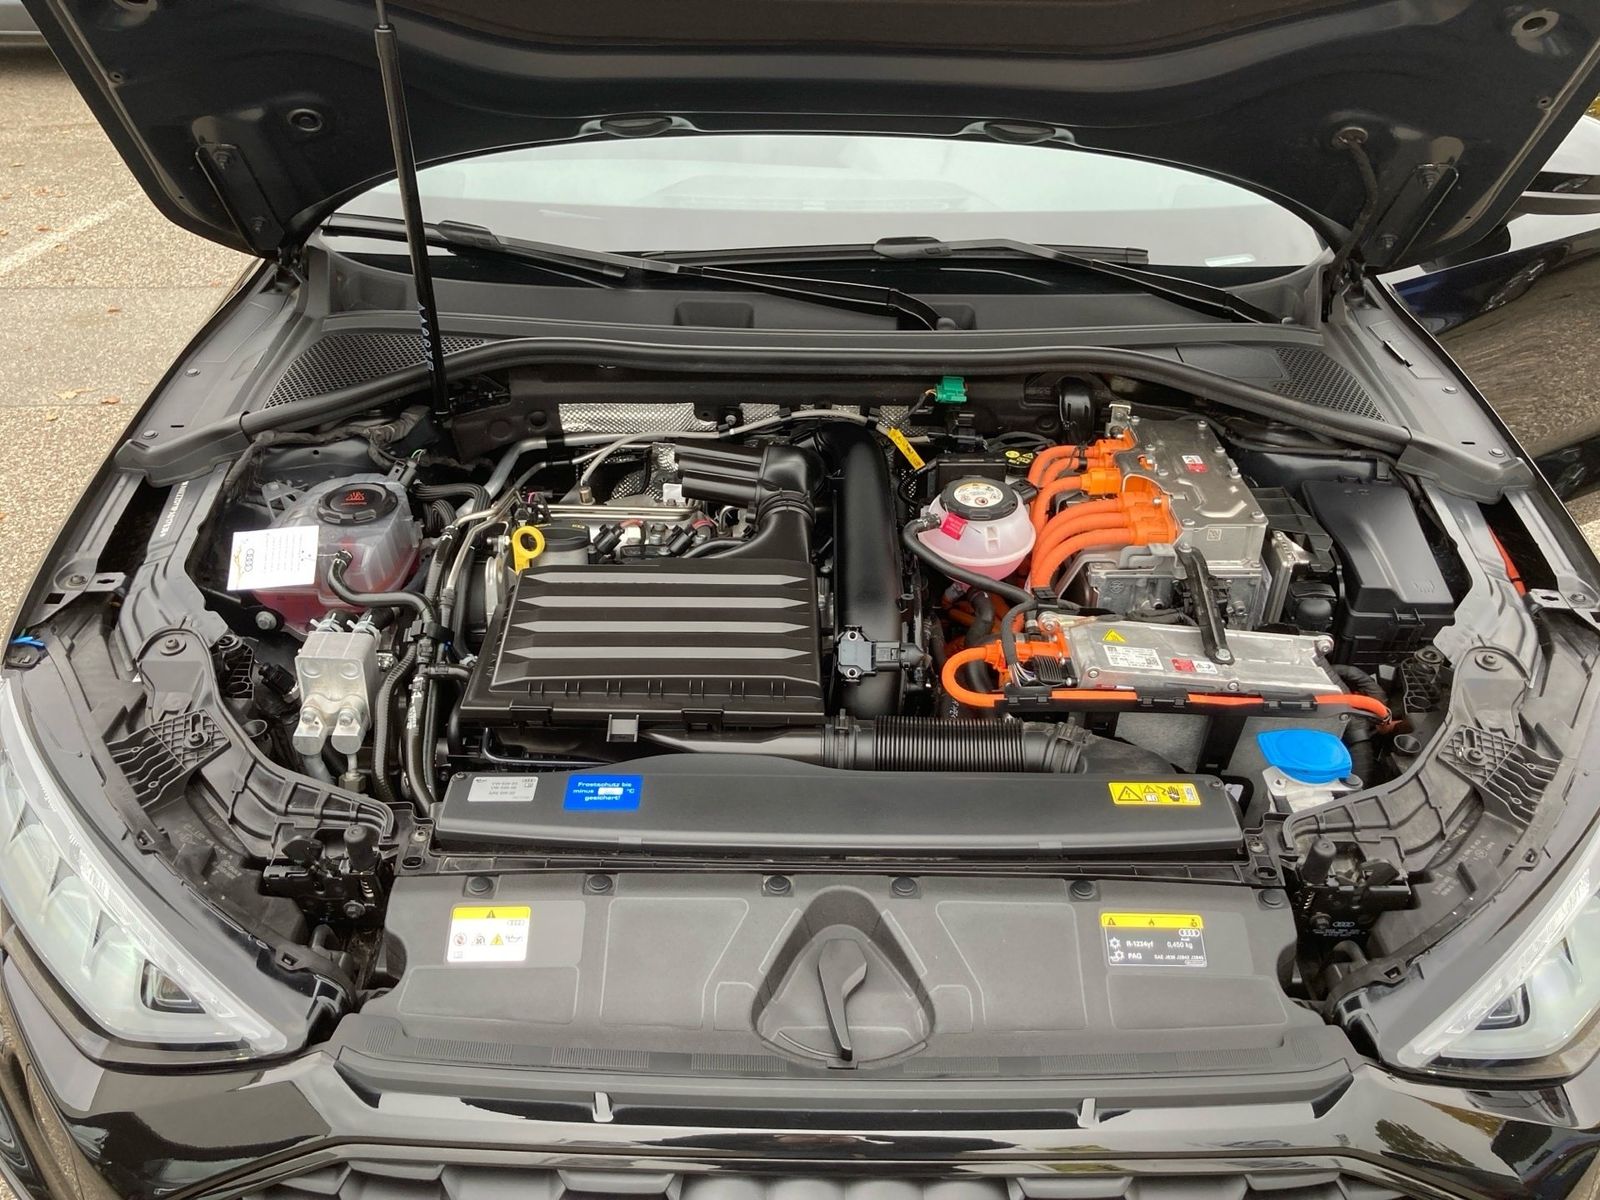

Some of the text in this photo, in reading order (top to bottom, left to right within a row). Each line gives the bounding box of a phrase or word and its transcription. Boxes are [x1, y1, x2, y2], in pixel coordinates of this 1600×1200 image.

[1125, 940, 1154, 949] R-1234yf
[1185, 941, 1193, 950] kg
[1127, 952, 1142, 960] PAG
